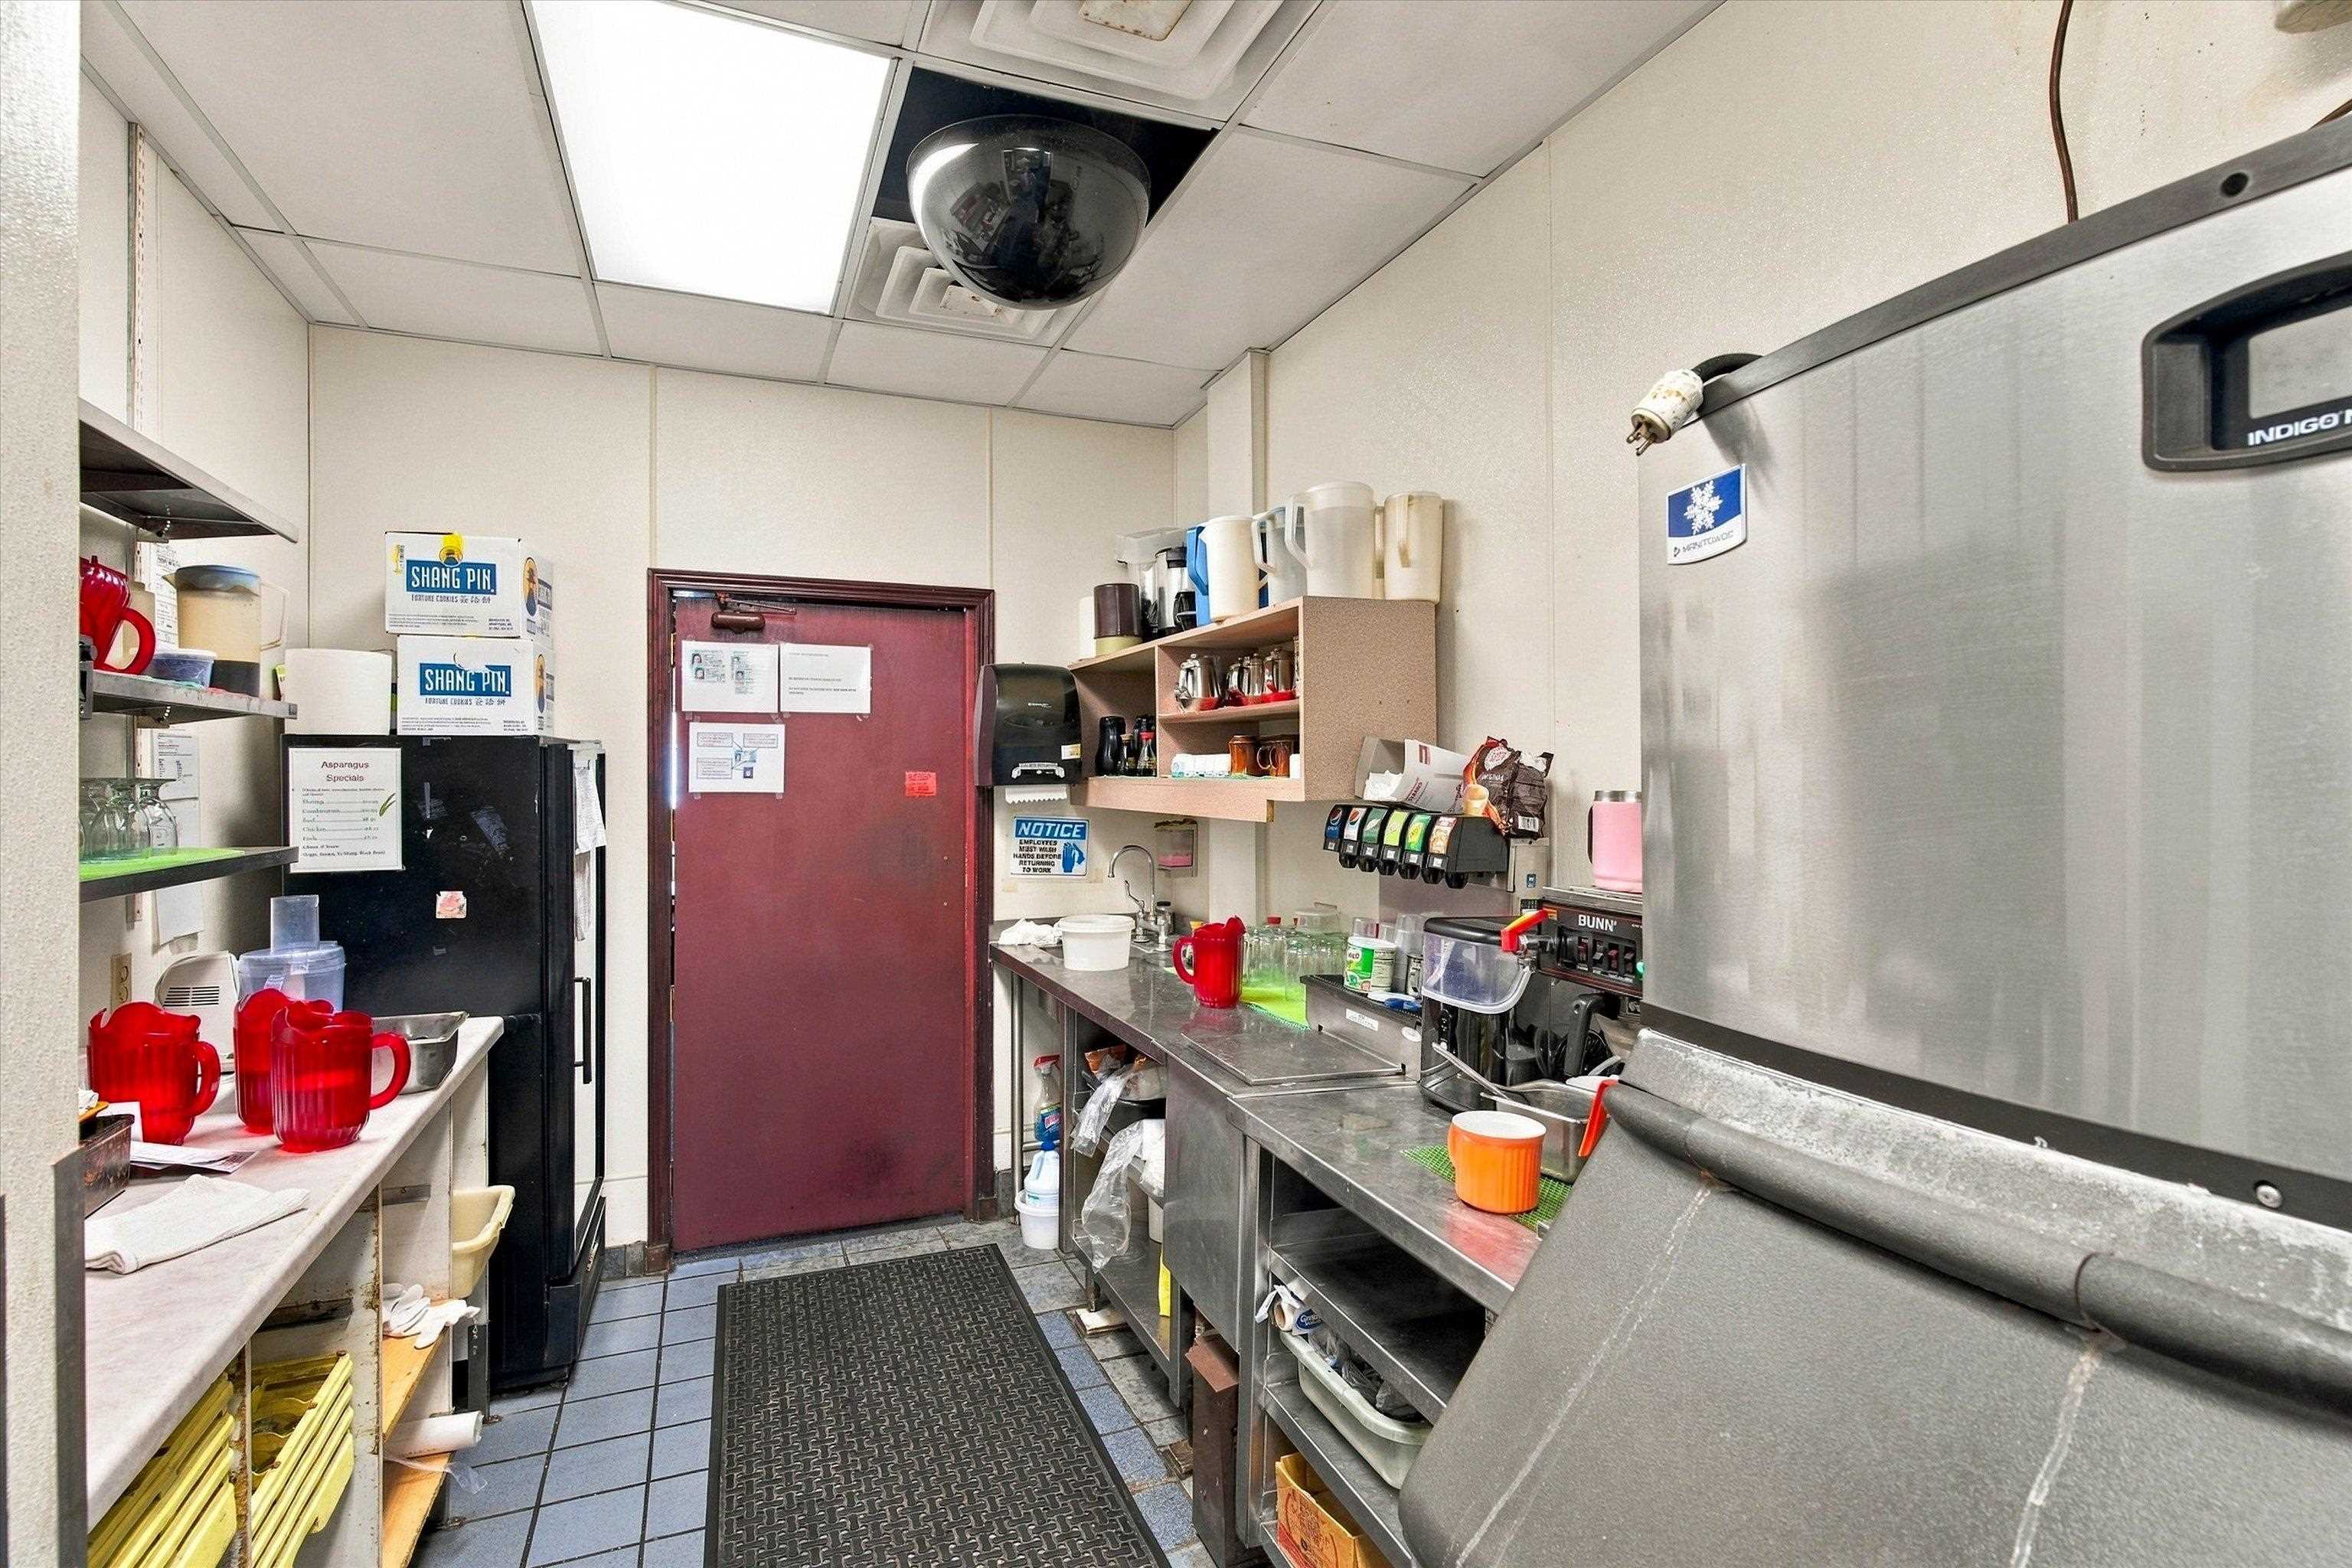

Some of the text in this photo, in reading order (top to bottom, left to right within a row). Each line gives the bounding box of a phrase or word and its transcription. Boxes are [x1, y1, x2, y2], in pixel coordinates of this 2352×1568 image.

[2248, 413, 2341, 446] INDIGO
[411, 567, 491, 590] SHANG PIN
[425, 668, 506, 692] SHANG PIN
[321, 761, 370, 770] Asparagus
[326, 774, 364, 782] Specials
[1018, 822, 1085, 838] NOTICE
[1578, 914, 1615, 932] BUNN
